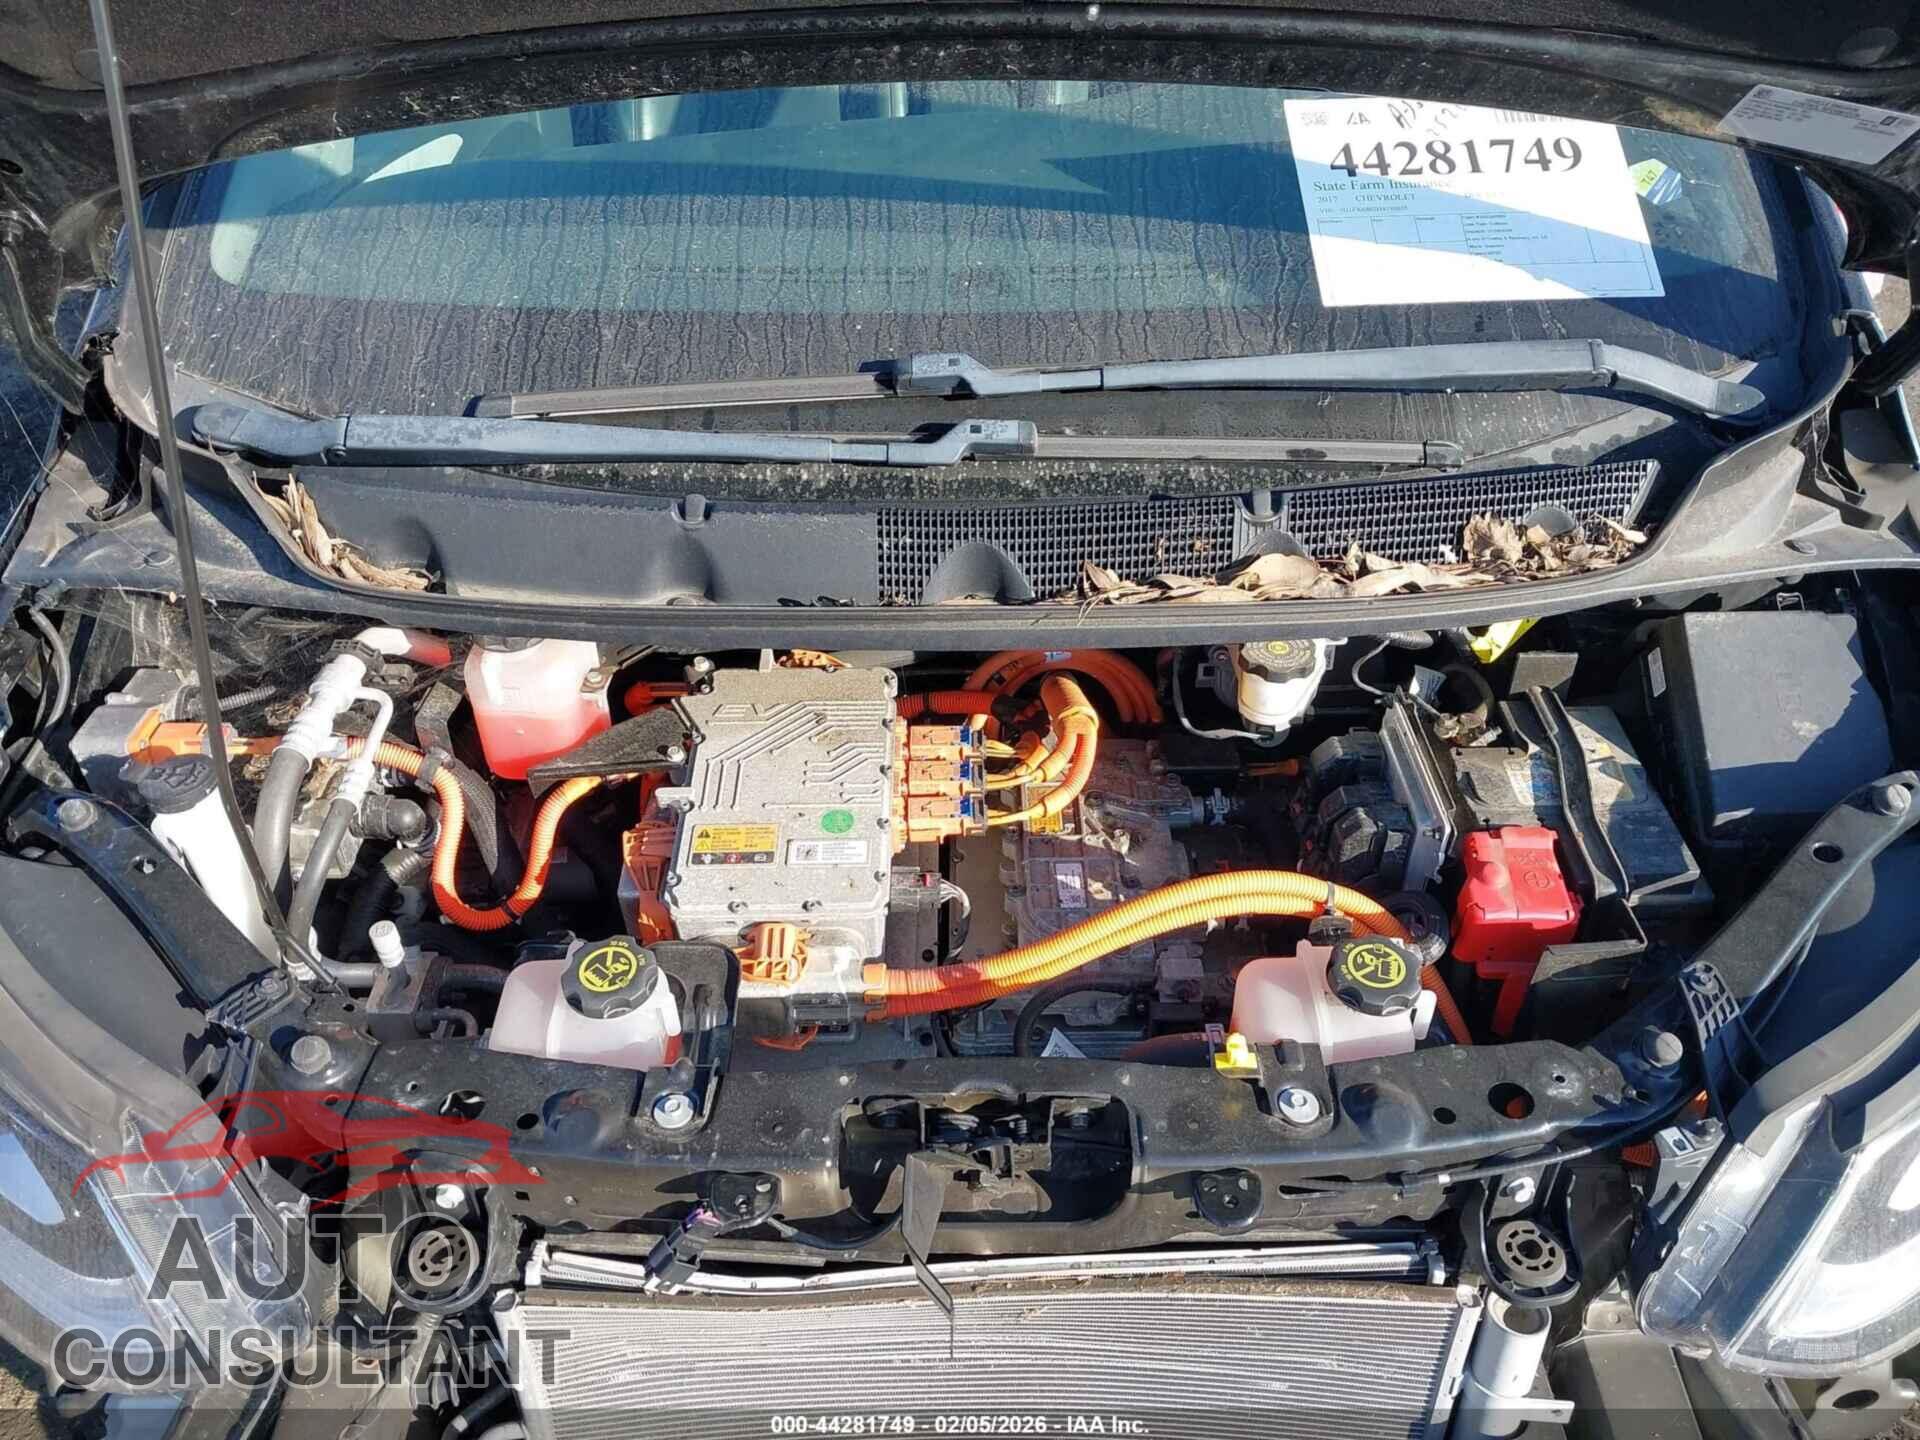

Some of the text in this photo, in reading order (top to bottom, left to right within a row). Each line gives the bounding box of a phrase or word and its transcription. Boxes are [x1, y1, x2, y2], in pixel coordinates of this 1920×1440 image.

[1330, 137, 1582, 177] 44281749
[1313, 181, 1346, 191] State
[1351, 180, 1385, 190] Farm
[1355, 193, 1415, 202] CHEVROLET
